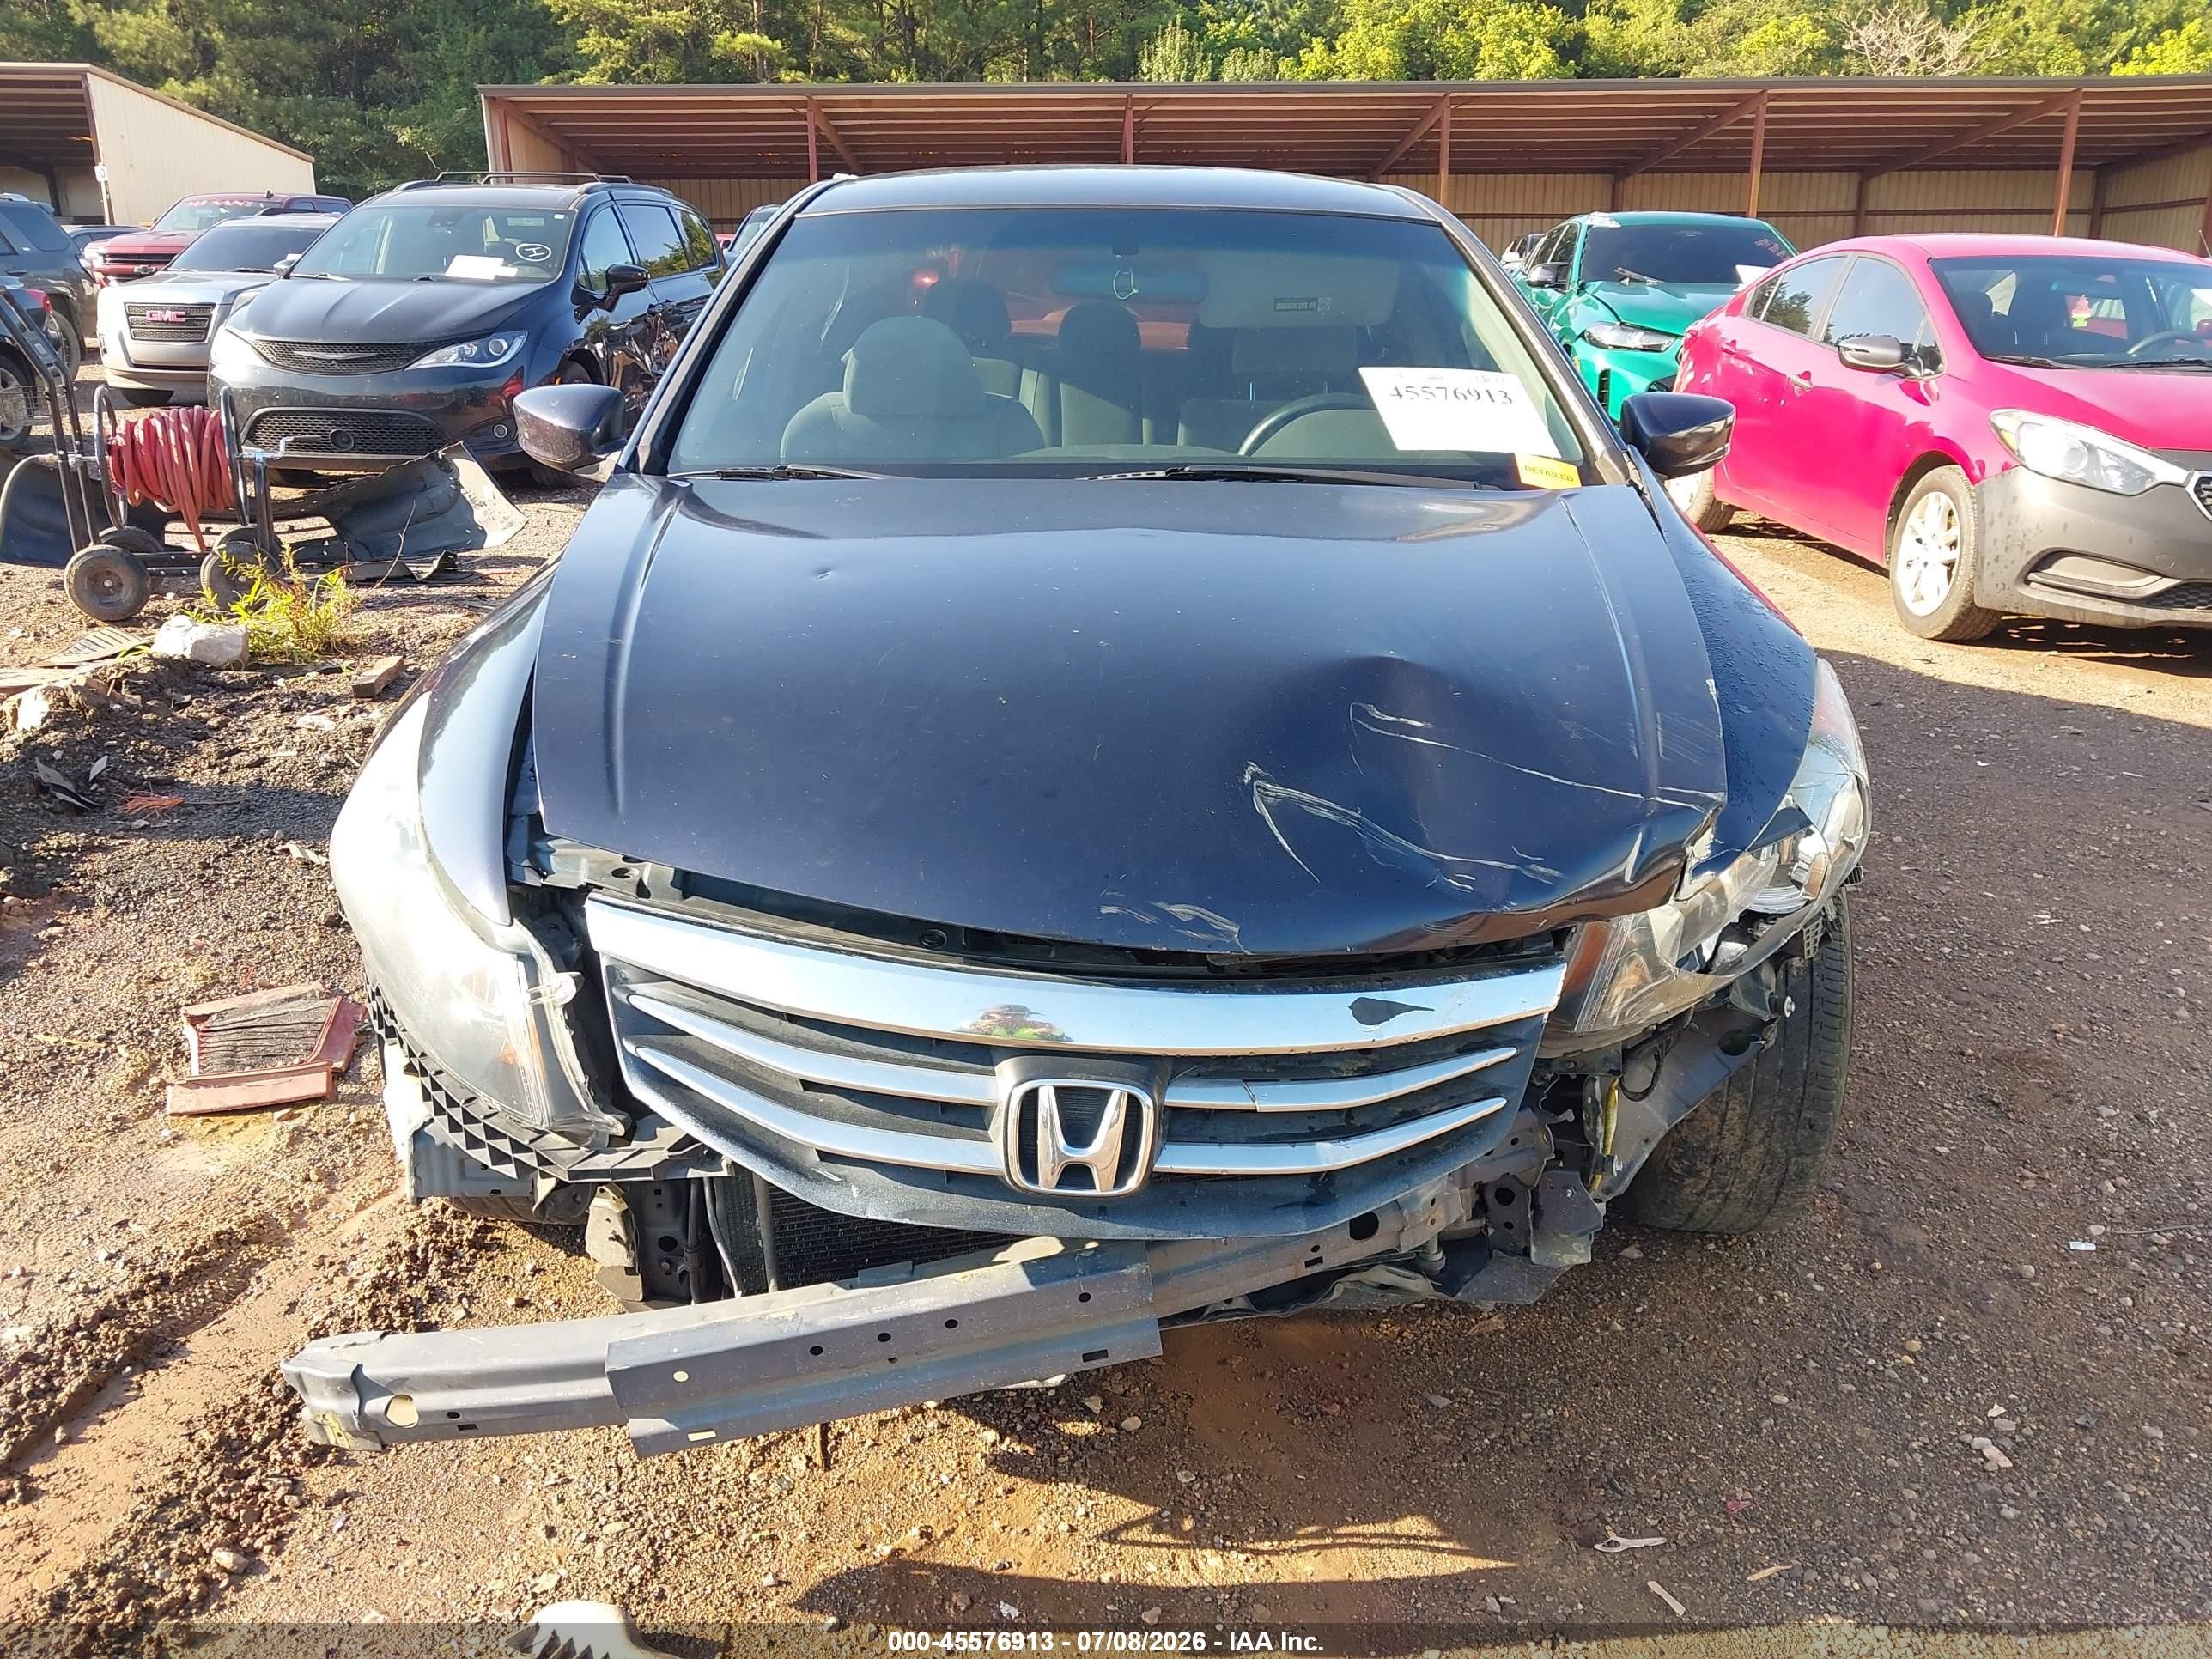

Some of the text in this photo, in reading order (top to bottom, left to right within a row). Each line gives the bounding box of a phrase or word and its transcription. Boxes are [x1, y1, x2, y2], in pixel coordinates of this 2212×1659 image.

[146, 310, 186, 322] GMC
[1389, 386, 1513, 404] 45576913
[1524, 465, 1574, 483] DETAILED
